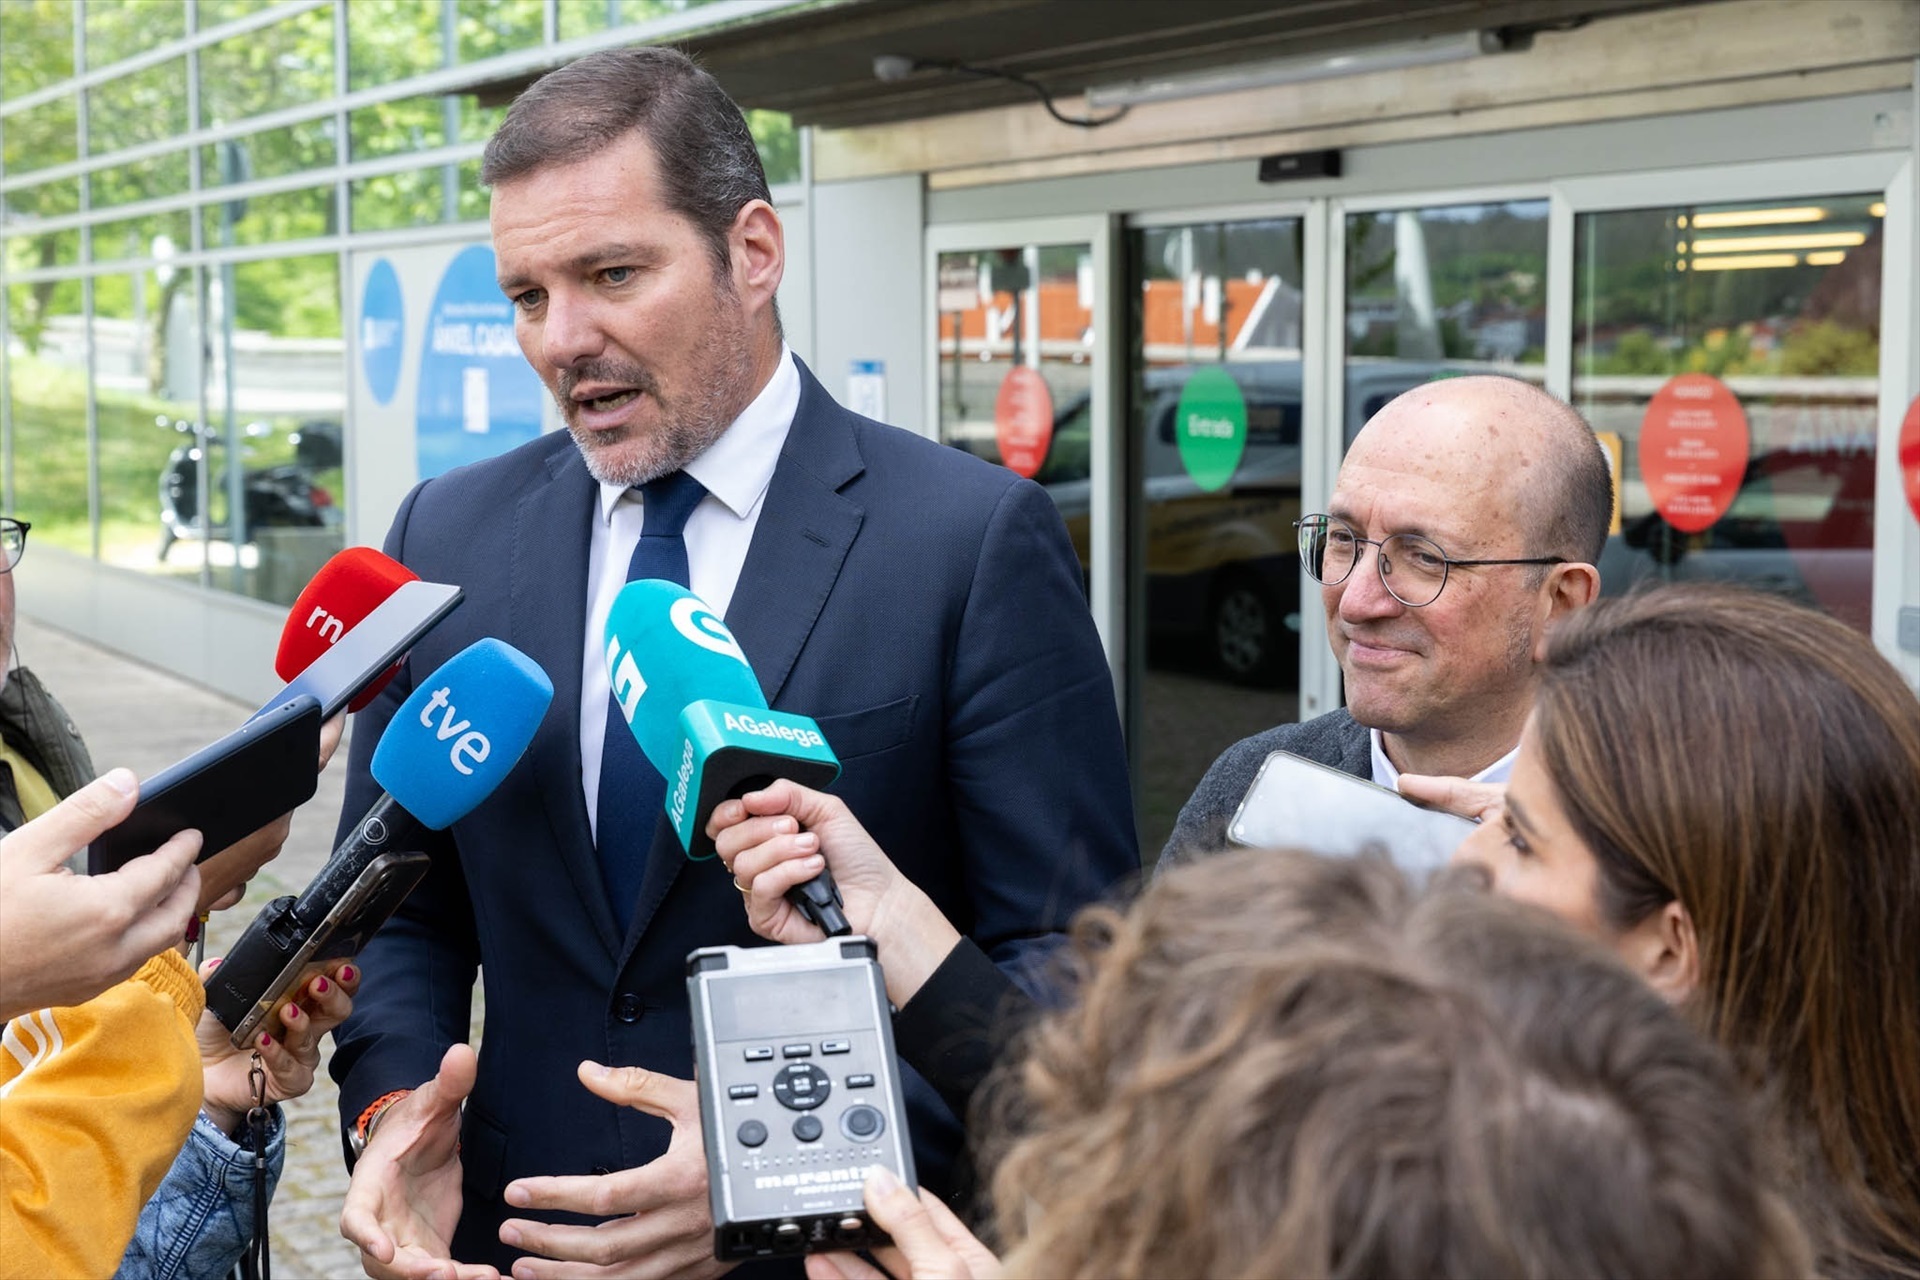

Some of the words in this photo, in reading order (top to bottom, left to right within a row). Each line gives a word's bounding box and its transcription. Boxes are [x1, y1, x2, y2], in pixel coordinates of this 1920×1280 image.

[305, 605, 344, 644] rn
[419, 686, 491, 775] tve
[723, 711, 825, 748] AGalega
[670, 737, 694, 834] AGalega
